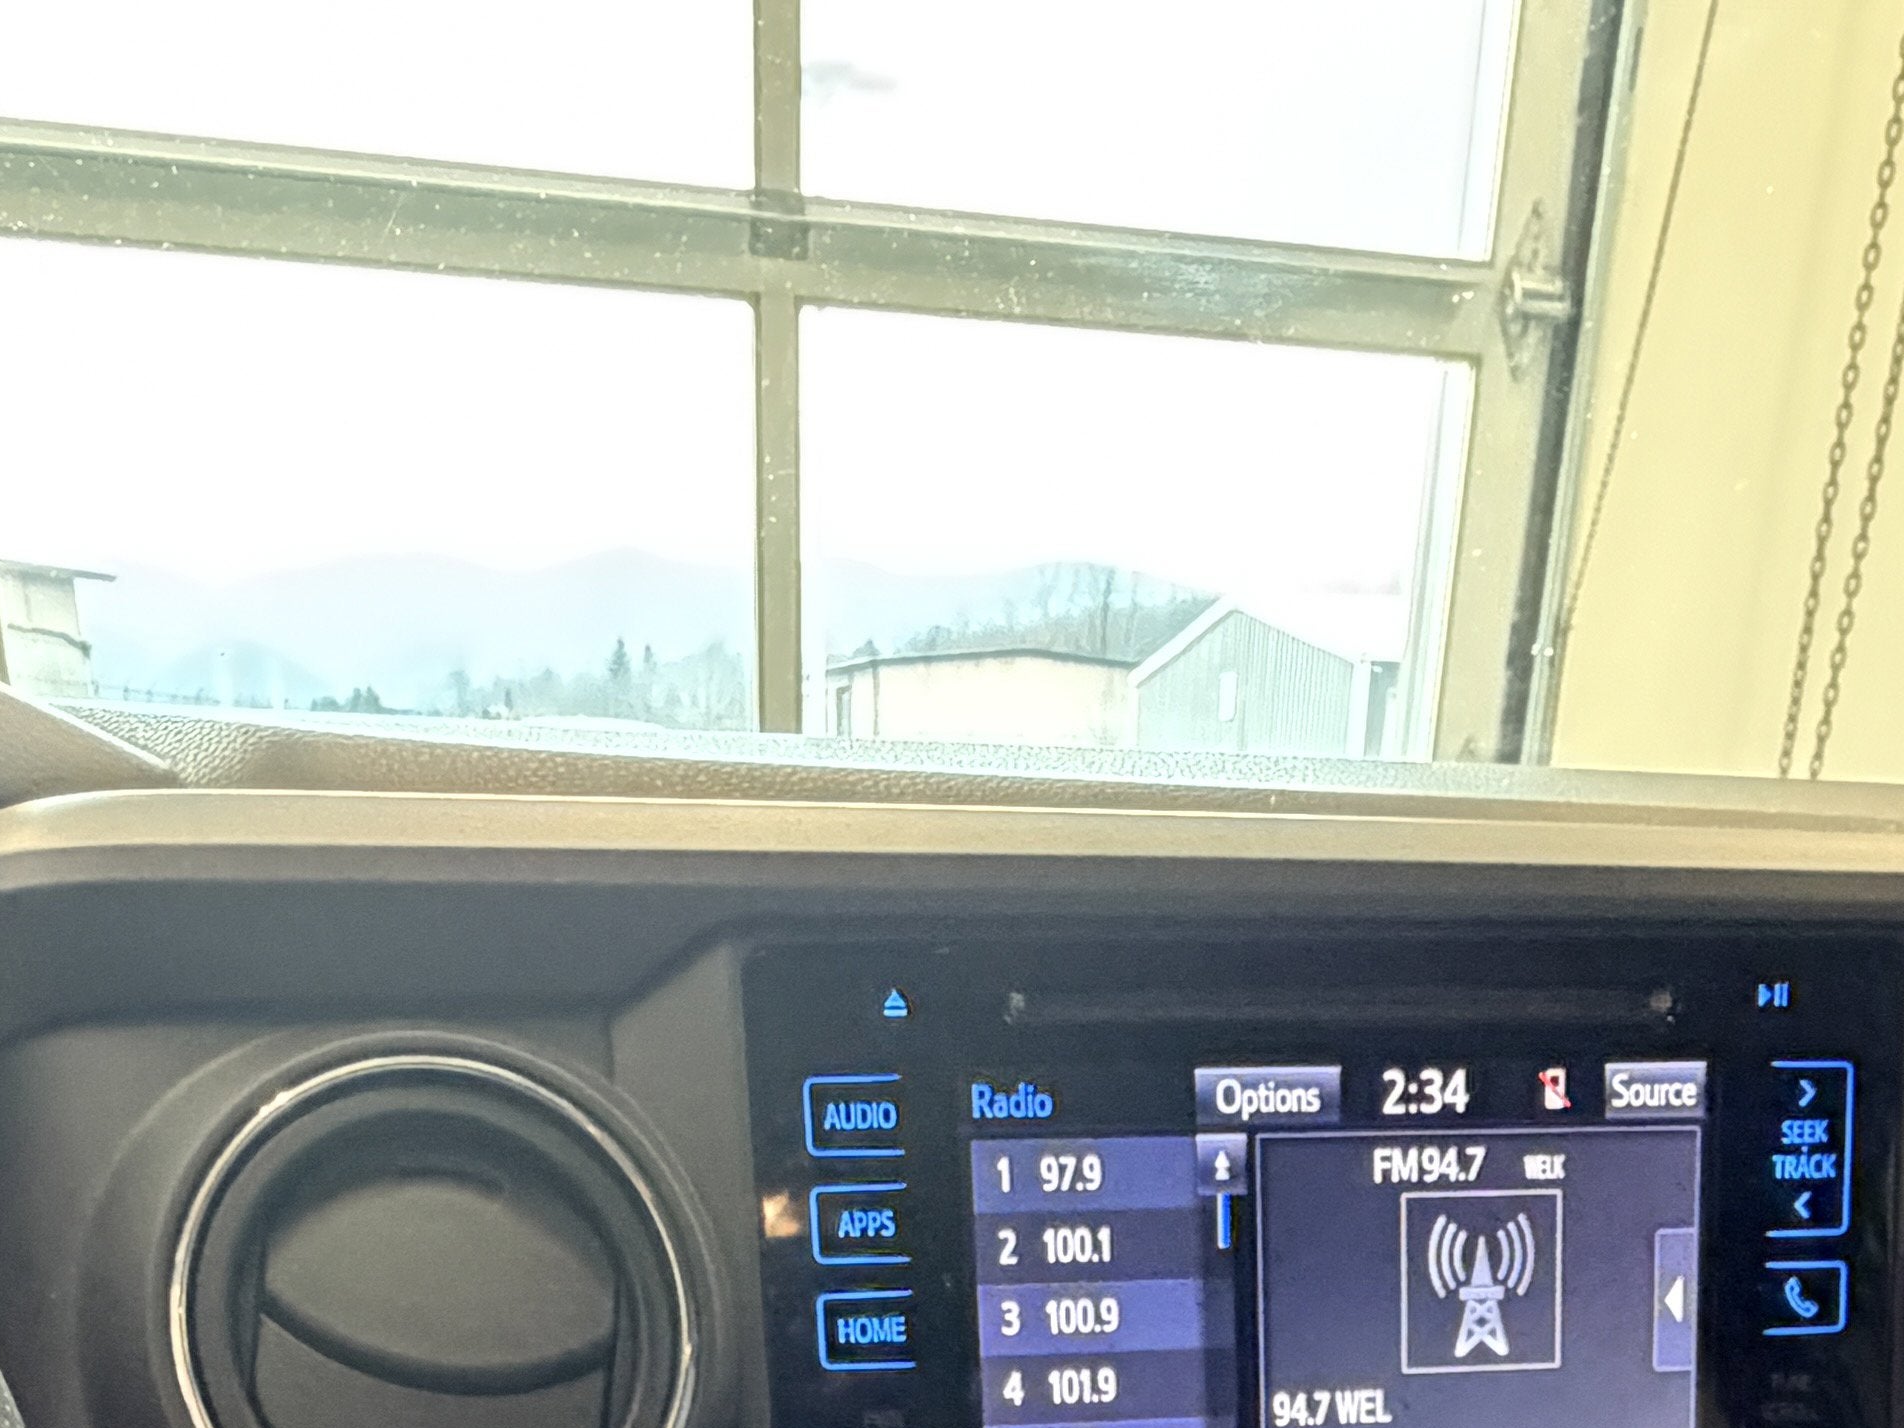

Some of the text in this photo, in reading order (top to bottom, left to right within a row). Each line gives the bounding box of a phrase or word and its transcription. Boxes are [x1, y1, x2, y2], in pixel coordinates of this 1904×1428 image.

[971, 1082, 1053, 1119] Radio
[1215, 1078, 1321, 1121] Options
[1382, 1067, 1470, 1114] 2:34
[1610, 1072, 1697, 1108] Source
[824, 1101, 898, 1131] AUDIO
[1780, 1119, 1829, 1145] SEEK
[996, 1153, 1103, 1193] 1 97.9
[1771, 1152, 1836, 1180] TRACK
[838, 1208, 896, 1238] APPS
[997, 1225, 1112, 1265] 2 100.1
[837, 1315, 907, 1344] HOME
[1000, 1297, 1119, 1336] 3 100.9
[1002, 1367, 1117, 1406] 4 101.9
[1272, 1388, 1393, 1427] 94.7 WEL
